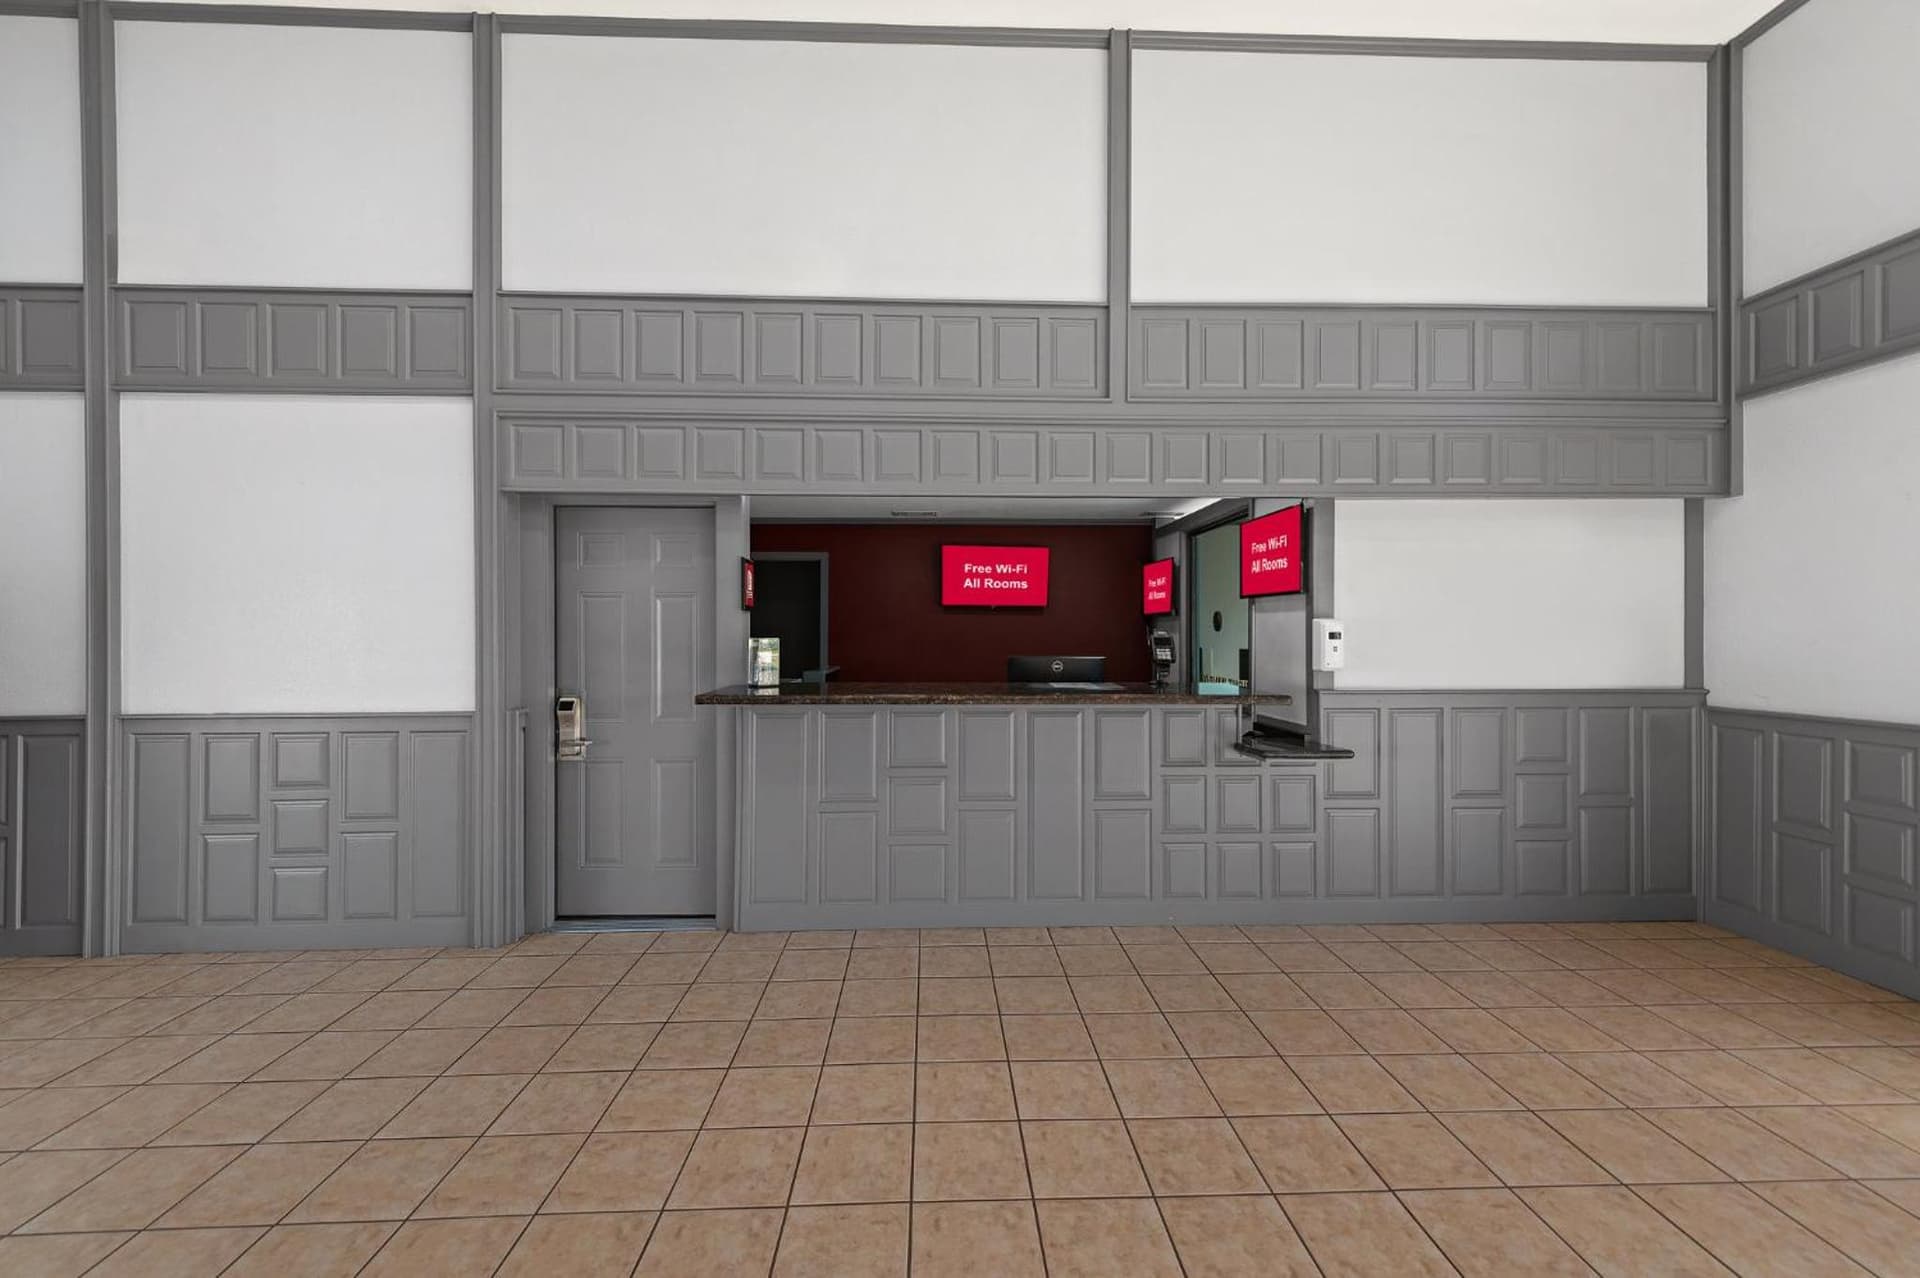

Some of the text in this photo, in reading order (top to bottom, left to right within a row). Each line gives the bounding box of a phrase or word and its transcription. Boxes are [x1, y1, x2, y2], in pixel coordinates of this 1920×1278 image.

[1251, 534, 1288, 555] Free Wi-Fi
[964, 563, 1028, 574] Free Wi-Fi
[1251, 558, 1288, 574] All Rooms
[963, 578, 1028, 589] All Rooms
